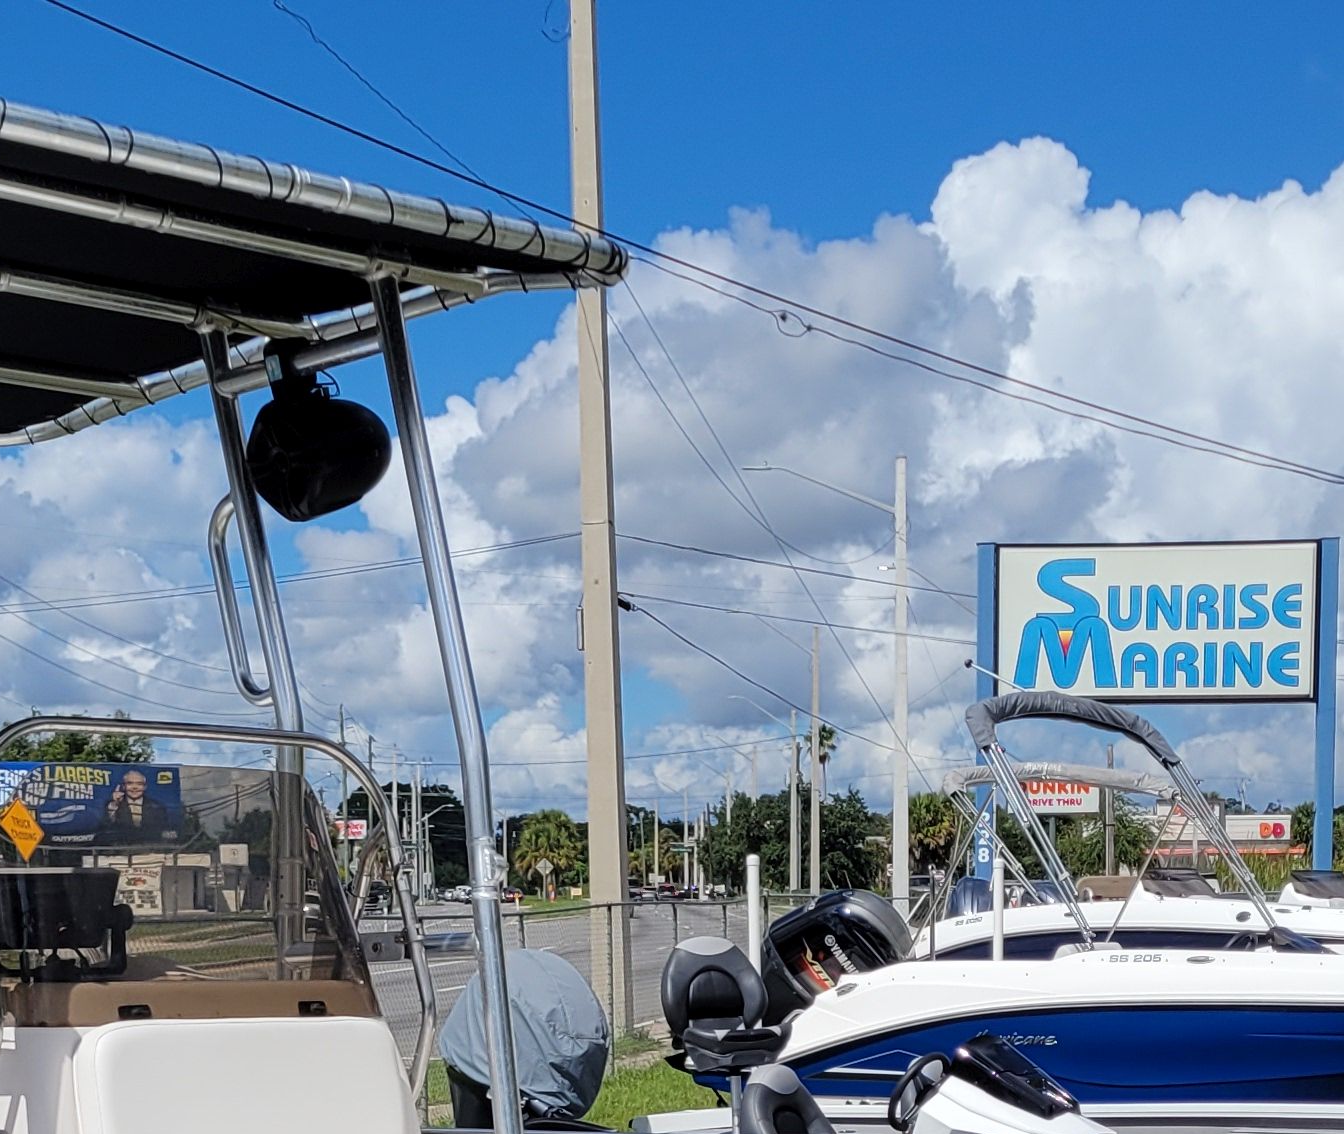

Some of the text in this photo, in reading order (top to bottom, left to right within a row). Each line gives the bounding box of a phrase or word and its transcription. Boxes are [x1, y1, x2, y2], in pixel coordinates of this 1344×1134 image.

[1035, 557, 1303, 631] SUNRISE
[1013, 615, 1300, 689] MARINE
[44, 766, 112, 786] LARGEST
[52, 782, 94, 800] FIRM
[1056, 798, 1083, 806] THRU
[1133, 953, 1163, 963] 205
